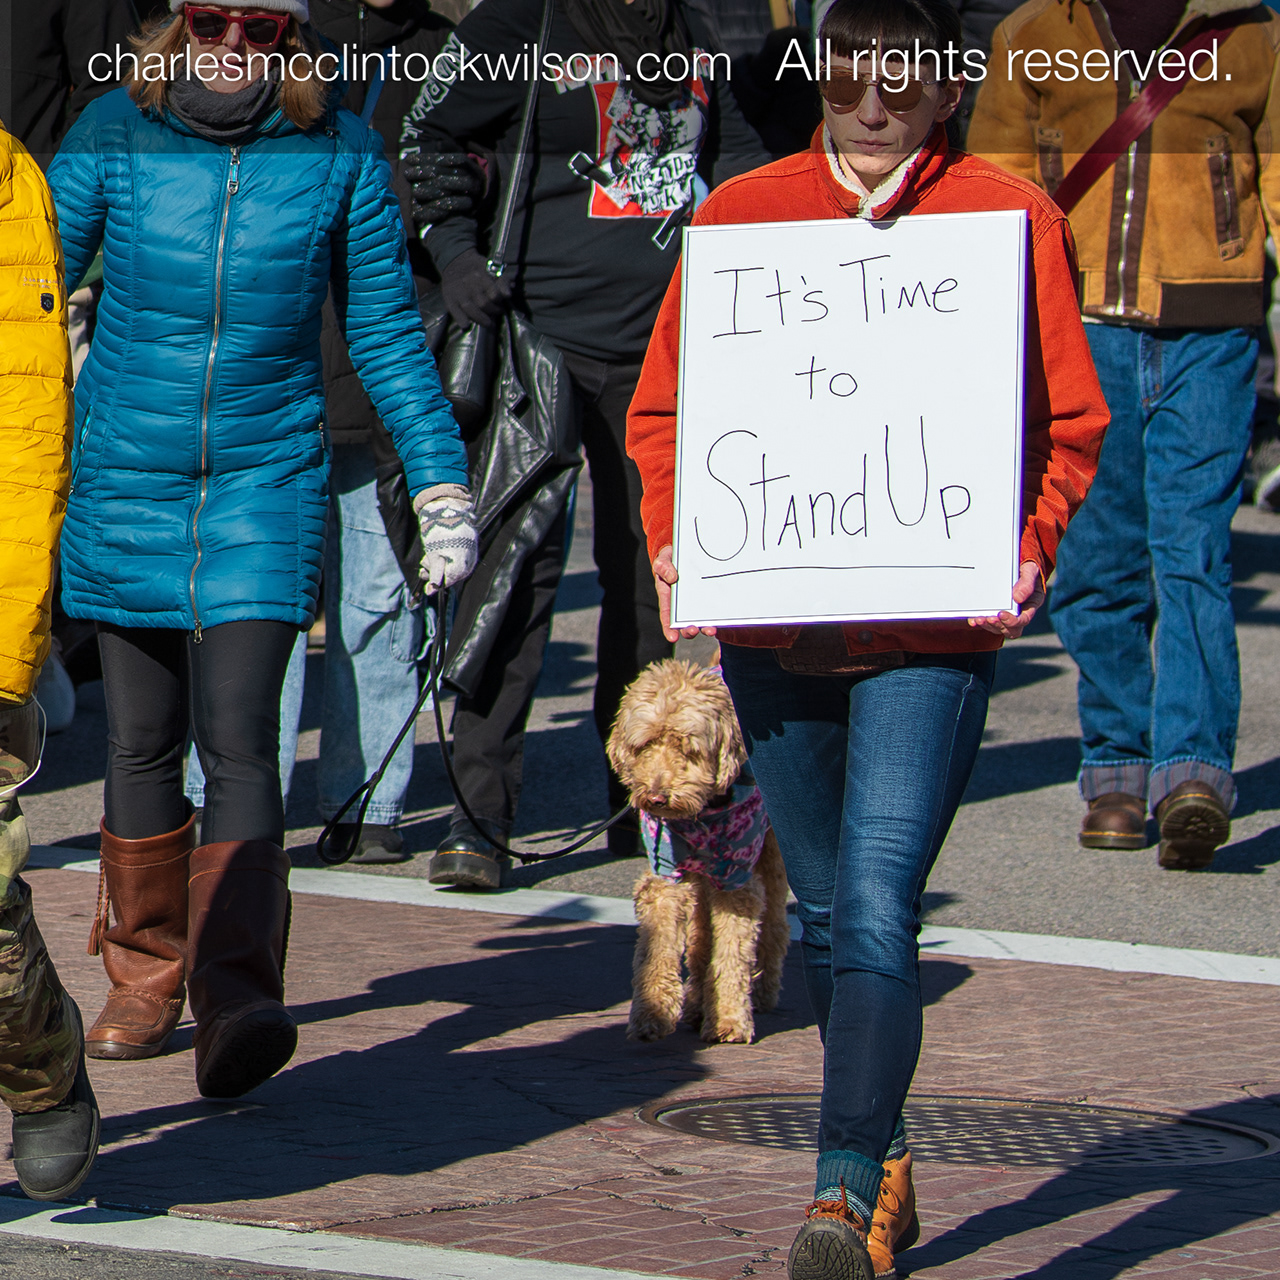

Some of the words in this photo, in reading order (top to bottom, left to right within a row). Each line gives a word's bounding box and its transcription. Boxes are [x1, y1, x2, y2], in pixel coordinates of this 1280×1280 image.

[713, 267, 828, 339] It's
[839, 255, 959, 323] Time
[795, 356, 858, 400] to
